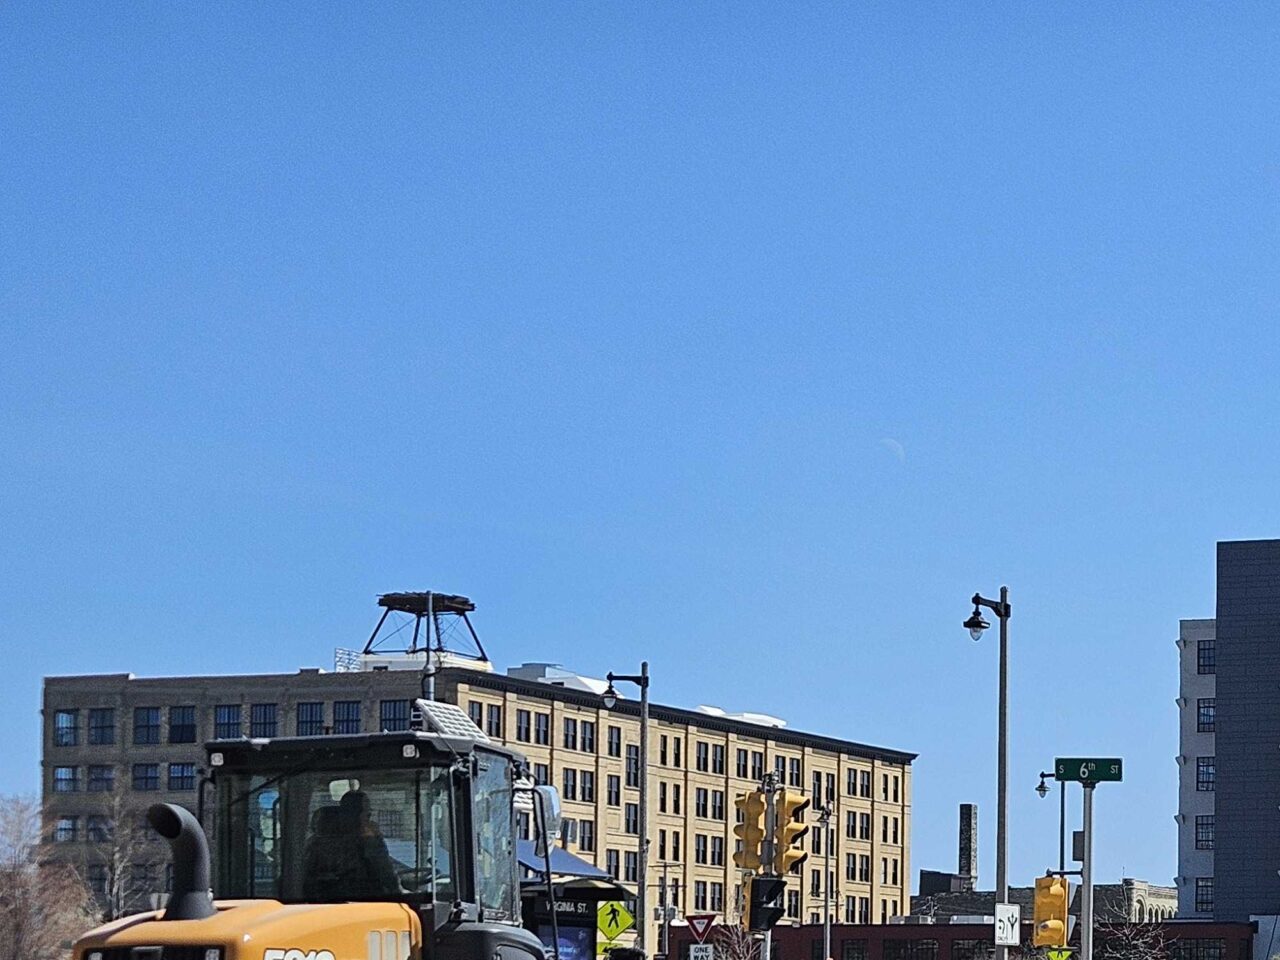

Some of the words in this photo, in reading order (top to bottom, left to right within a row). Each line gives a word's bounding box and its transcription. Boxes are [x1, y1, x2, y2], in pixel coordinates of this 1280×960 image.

[1058, 764, 1065, 774] S
[1079, 762, 1096, 778] 6th
[1110, 765, 1119, 774] ST
[545, 901, 575, 912] VRGINIA
[577, 903, 588, 913] ST.
[694, 946, 710, 954] ONE
